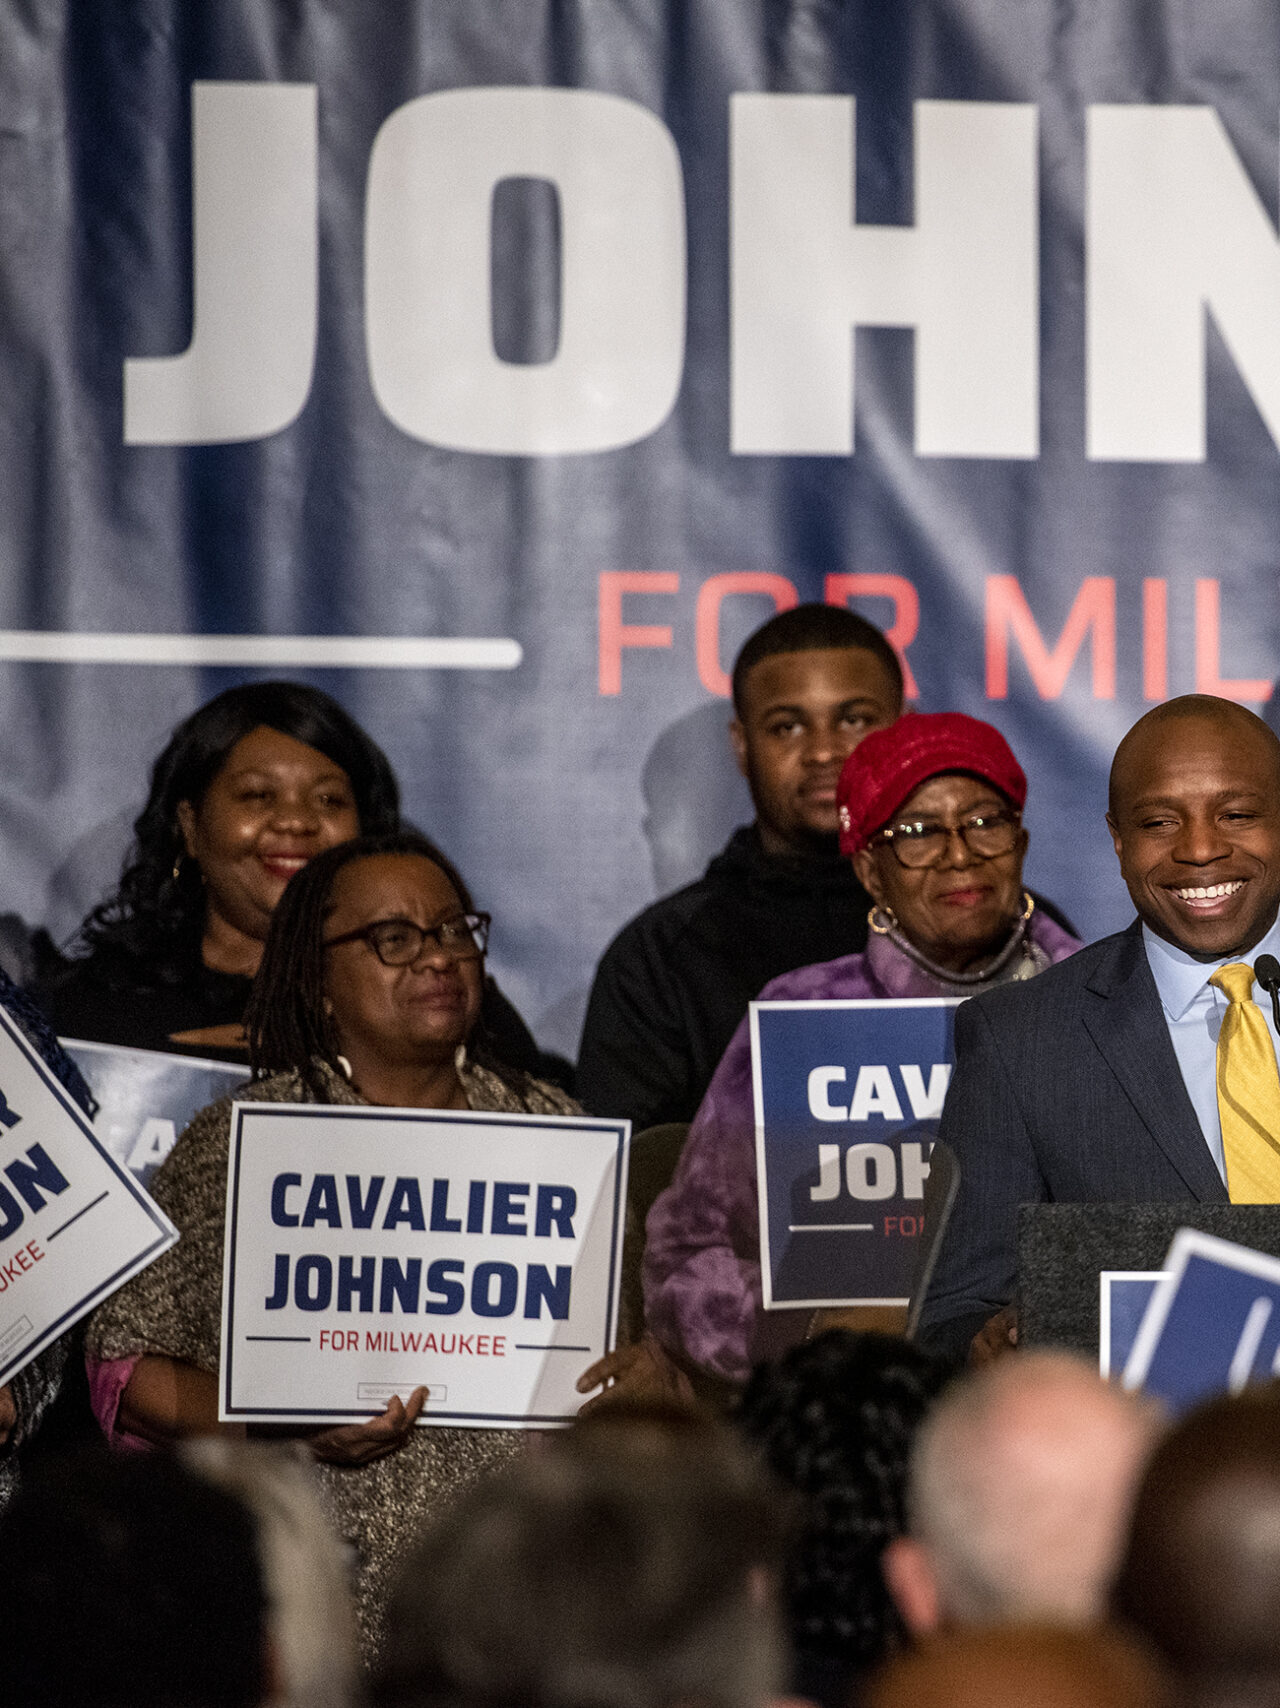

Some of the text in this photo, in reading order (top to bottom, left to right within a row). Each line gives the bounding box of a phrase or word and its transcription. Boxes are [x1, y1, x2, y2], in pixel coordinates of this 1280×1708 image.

[270, 1171, 578, 1239] CAVALIER
[264, 1252, 573, 1321] JOHNSON
[319, 1329, 507, 1357] FOR MILWAUKEE
